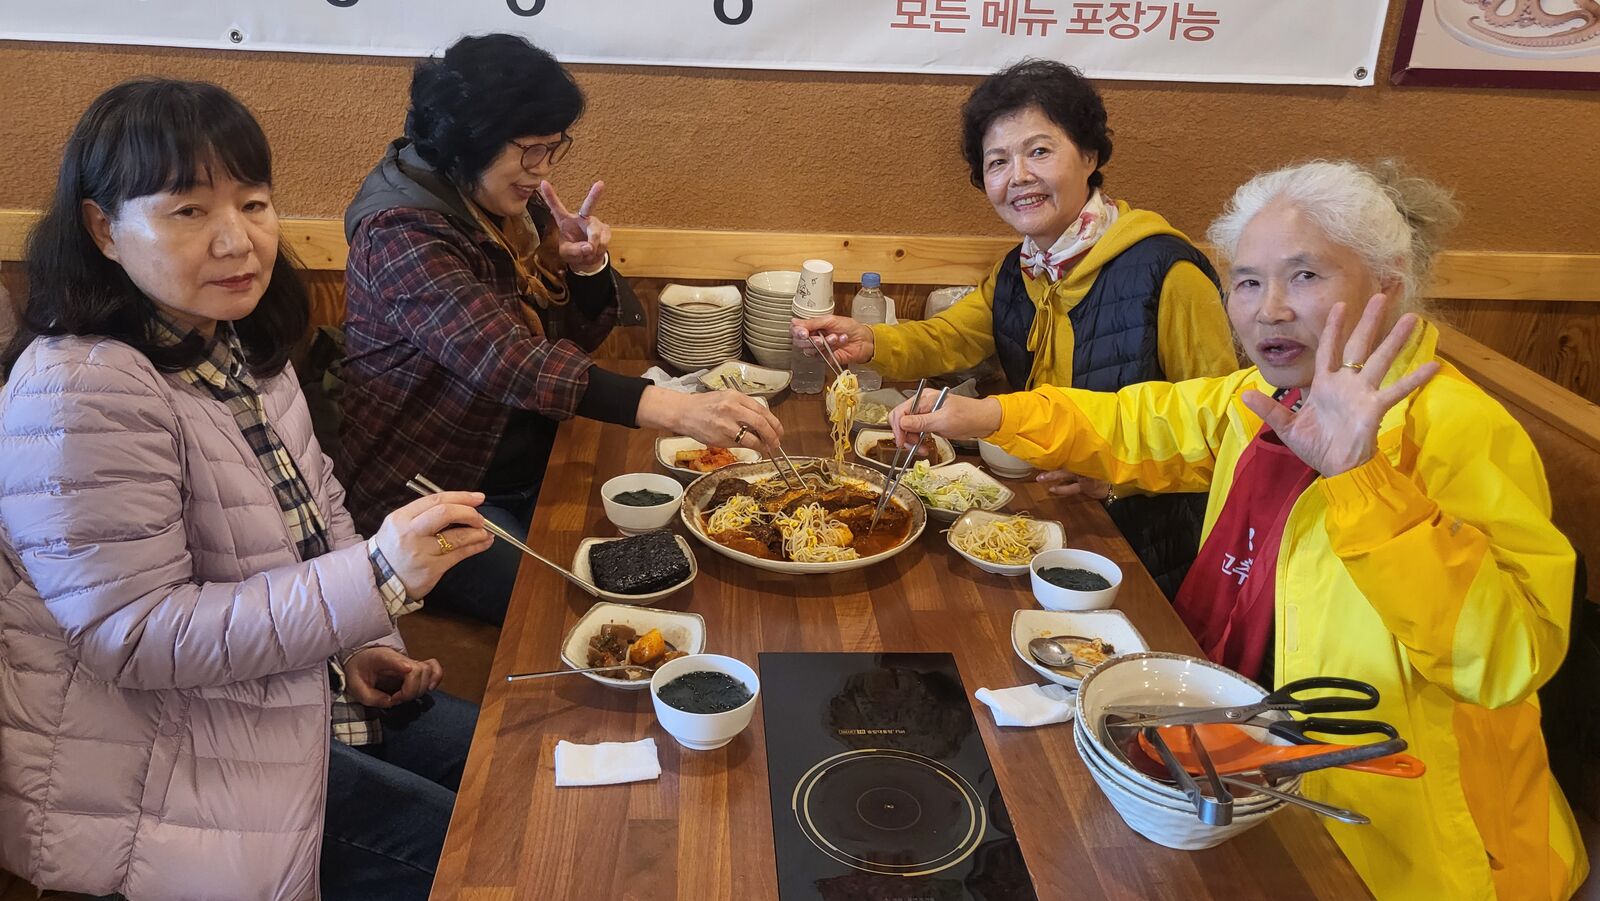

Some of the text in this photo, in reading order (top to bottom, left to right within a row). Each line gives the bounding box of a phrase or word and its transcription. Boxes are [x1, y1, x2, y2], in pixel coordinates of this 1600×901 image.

[890, 0, 1220, 41] 모든 메뉴 포장가능
